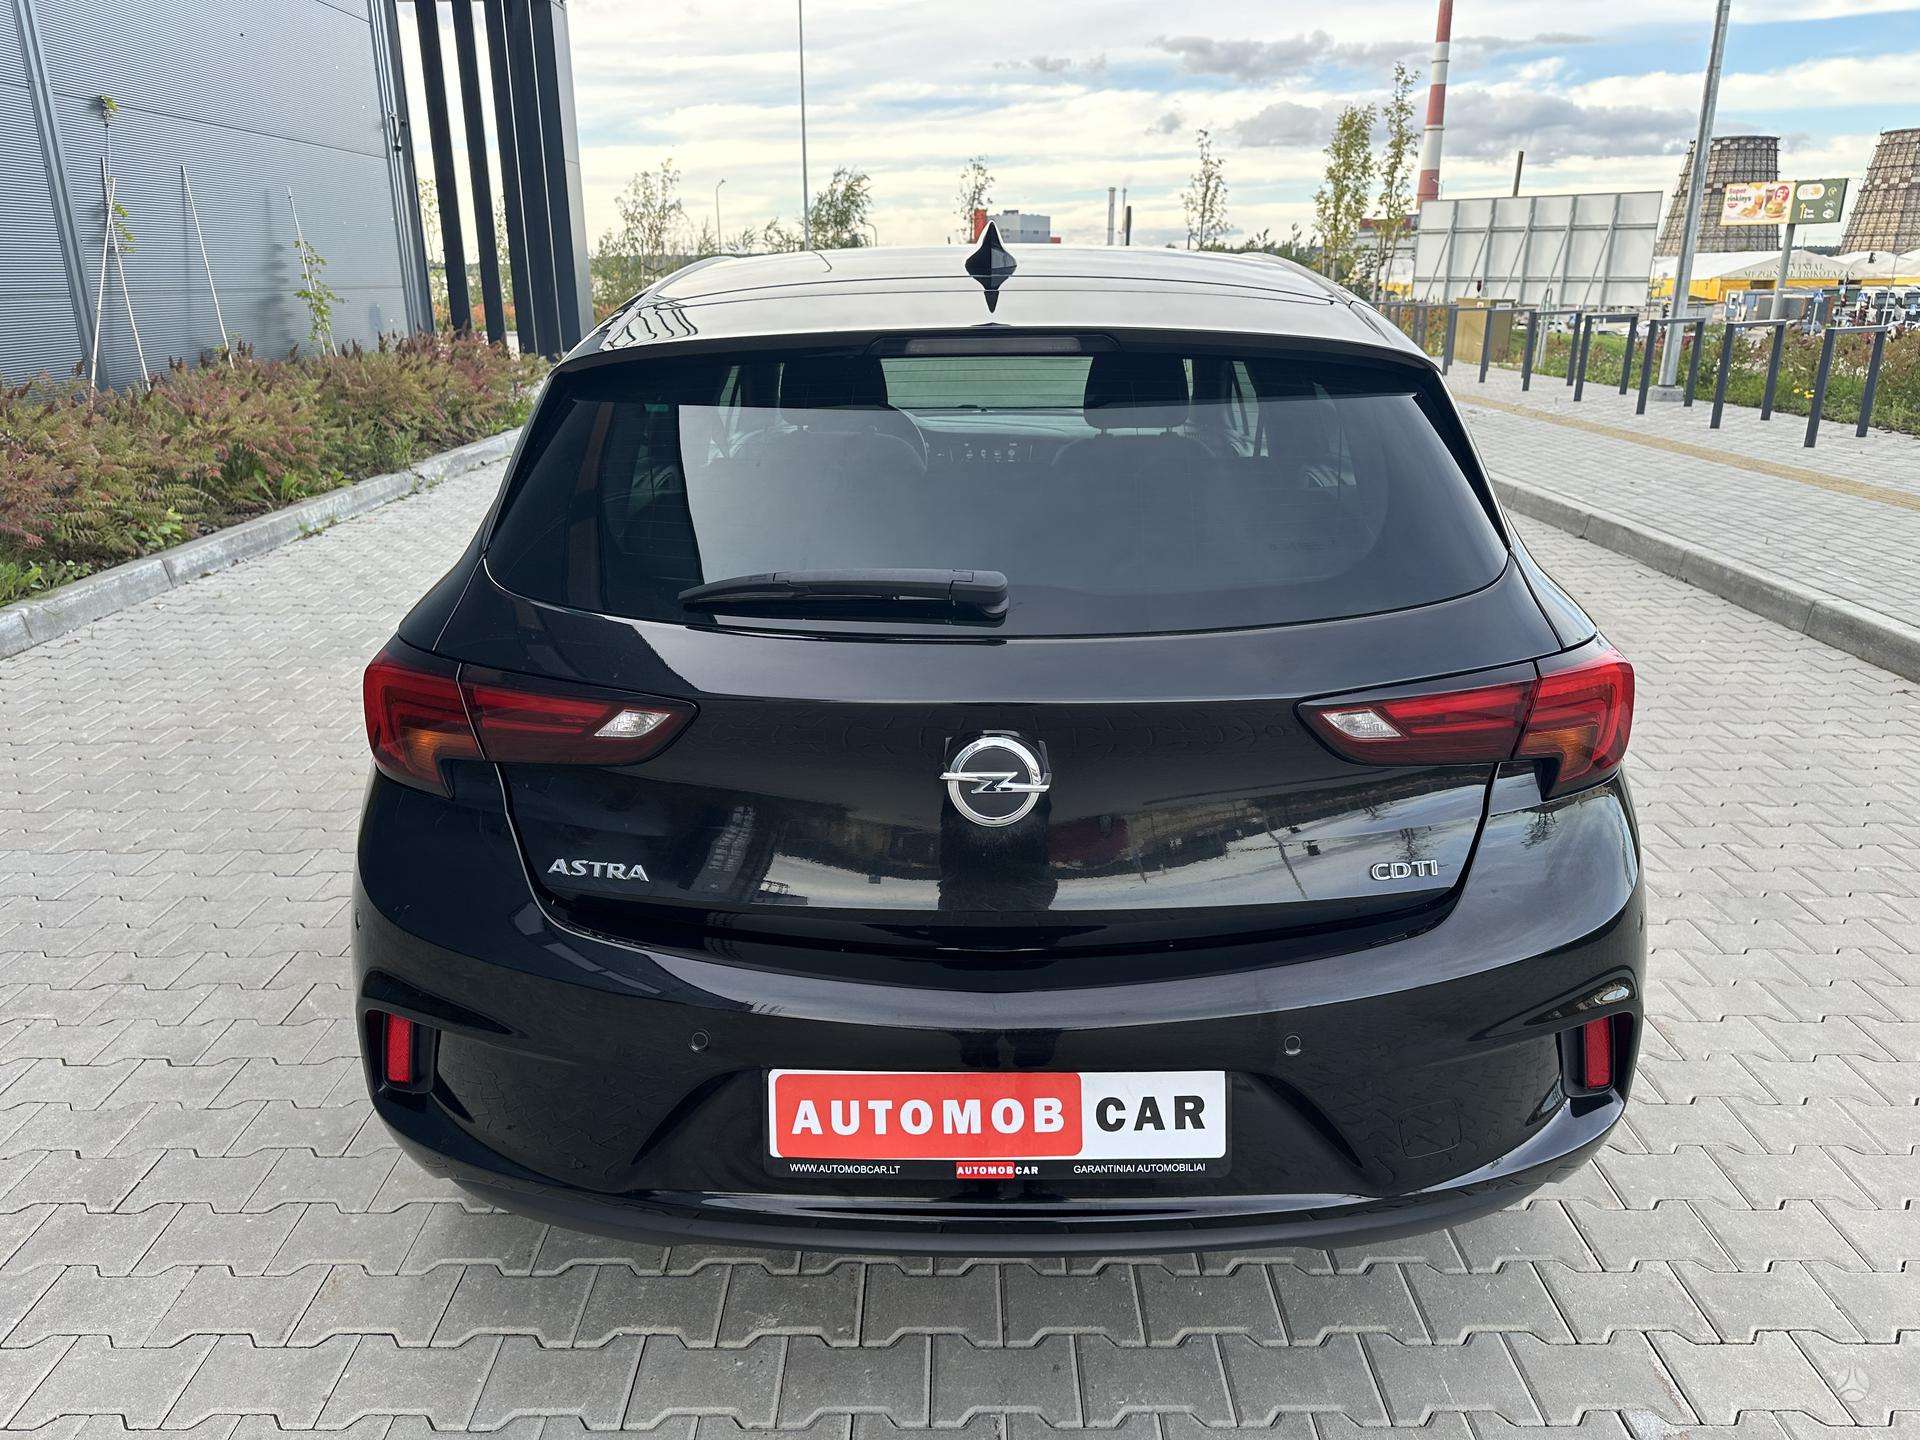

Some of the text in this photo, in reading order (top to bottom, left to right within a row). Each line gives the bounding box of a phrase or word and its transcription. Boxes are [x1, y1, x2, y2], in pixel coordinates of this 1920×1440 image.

[547, 858, 650, 882] ASTRA
[1371, 859, 1438, 880] CDTI
[791, 1095, 1206, 1135] AUTOMOB CAR
[789, 1163, 901, 1175] WWW.AUTOMOBCAR.LT
[1073, 1162, 1206, 1174] GARANTINIAI AUTOMOBILIAI
